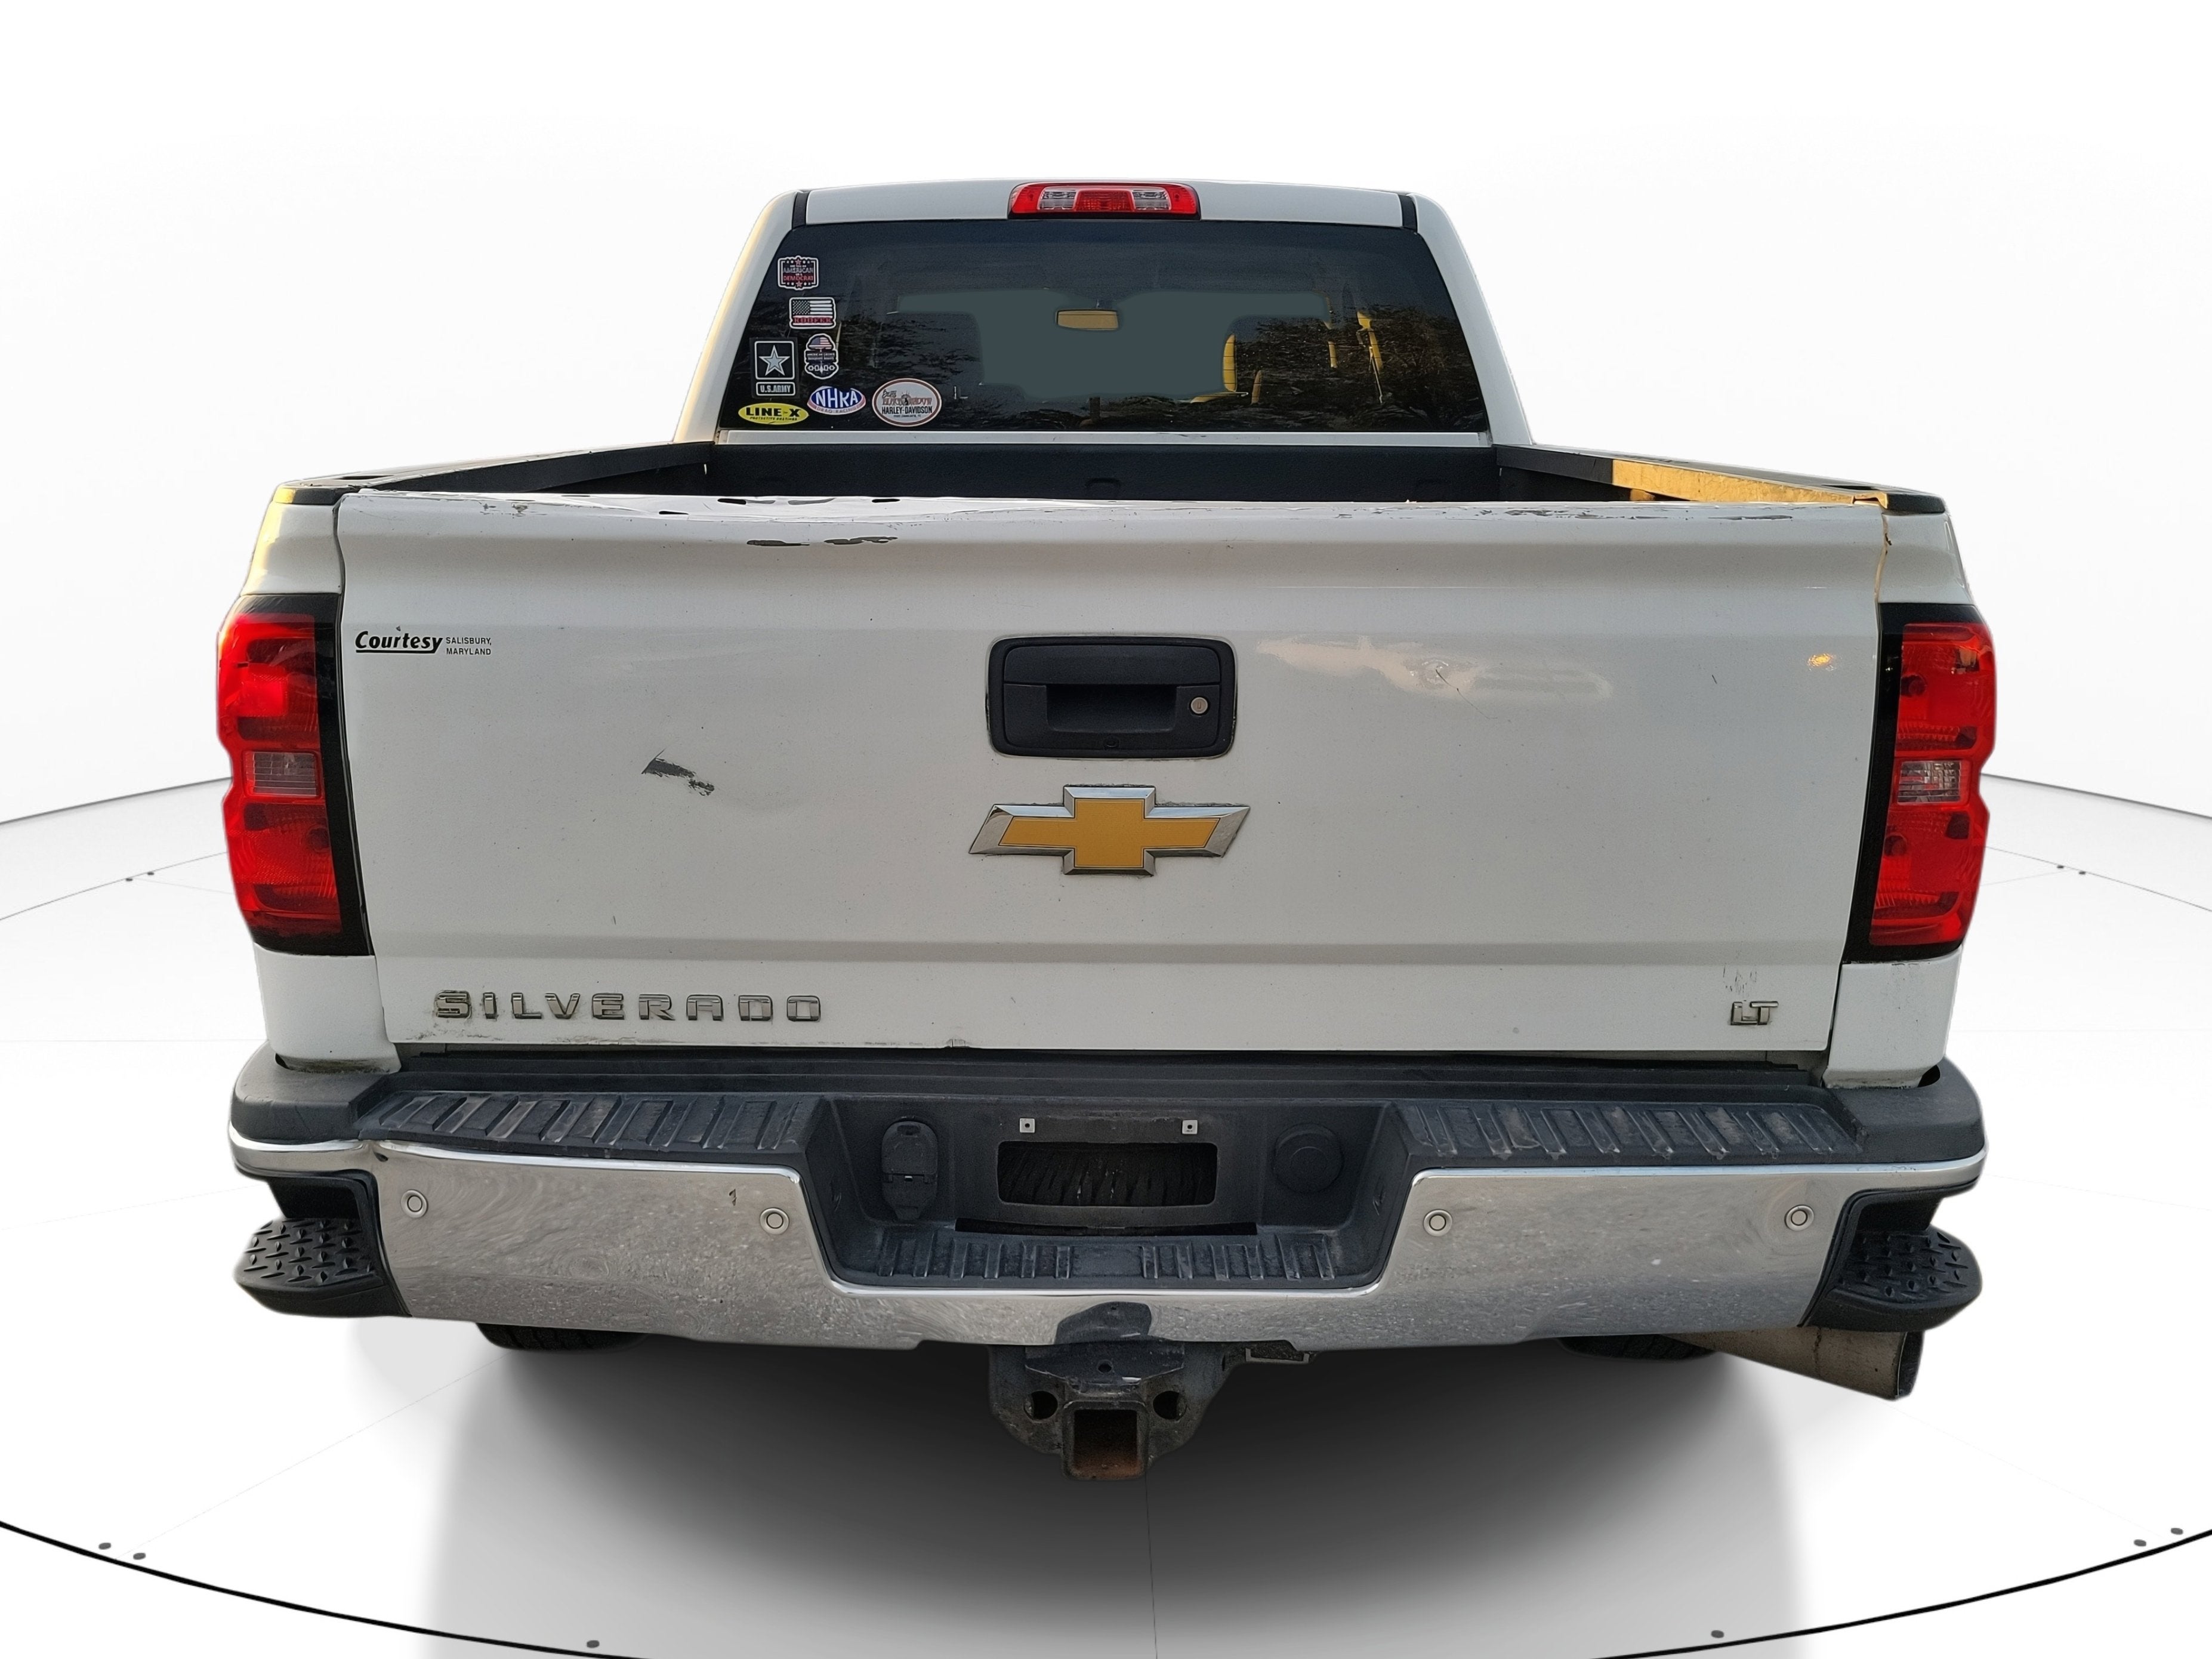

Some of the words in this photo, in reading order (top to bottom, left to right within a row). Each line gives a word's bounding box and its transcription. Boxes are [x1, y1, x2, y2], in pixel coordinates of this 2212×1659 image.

[746, 407, 802, 417] LINE-X
[882, 406, 933, 414] HARLEY-DAVIDSON
[355, 630, 443, 653] Courtesy
[446, 637, 492, 646] SALISBURY,
[435, 990, 822, 1022] SILVERADO
[1730, 1001, 1779, 1025] LT
